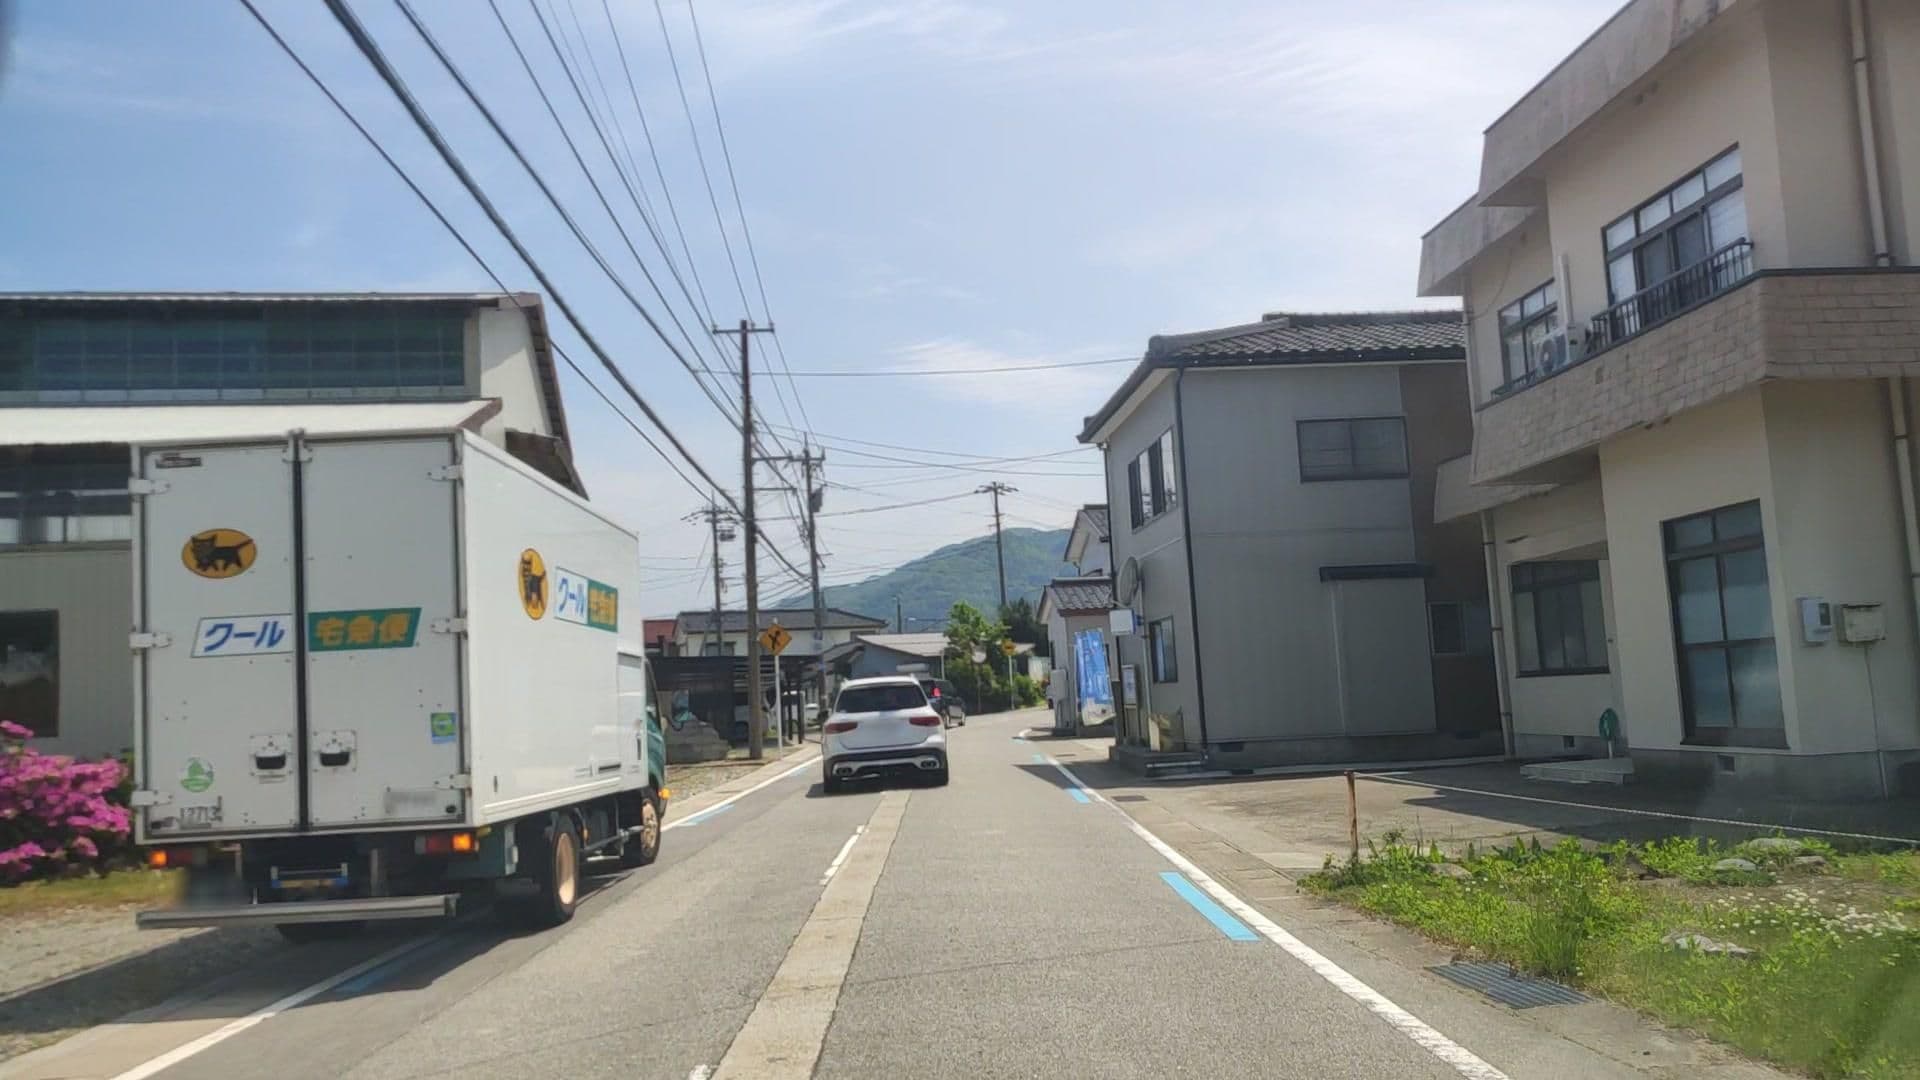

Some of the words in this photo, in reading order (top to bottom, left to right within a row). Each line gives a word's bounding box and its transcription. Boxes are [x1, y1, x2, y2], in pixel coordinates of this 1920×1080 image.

[558, 577, 585, 617] クール
[204, 620, 286, 653] クール
[315, 611, 411, 648] 宅急便
